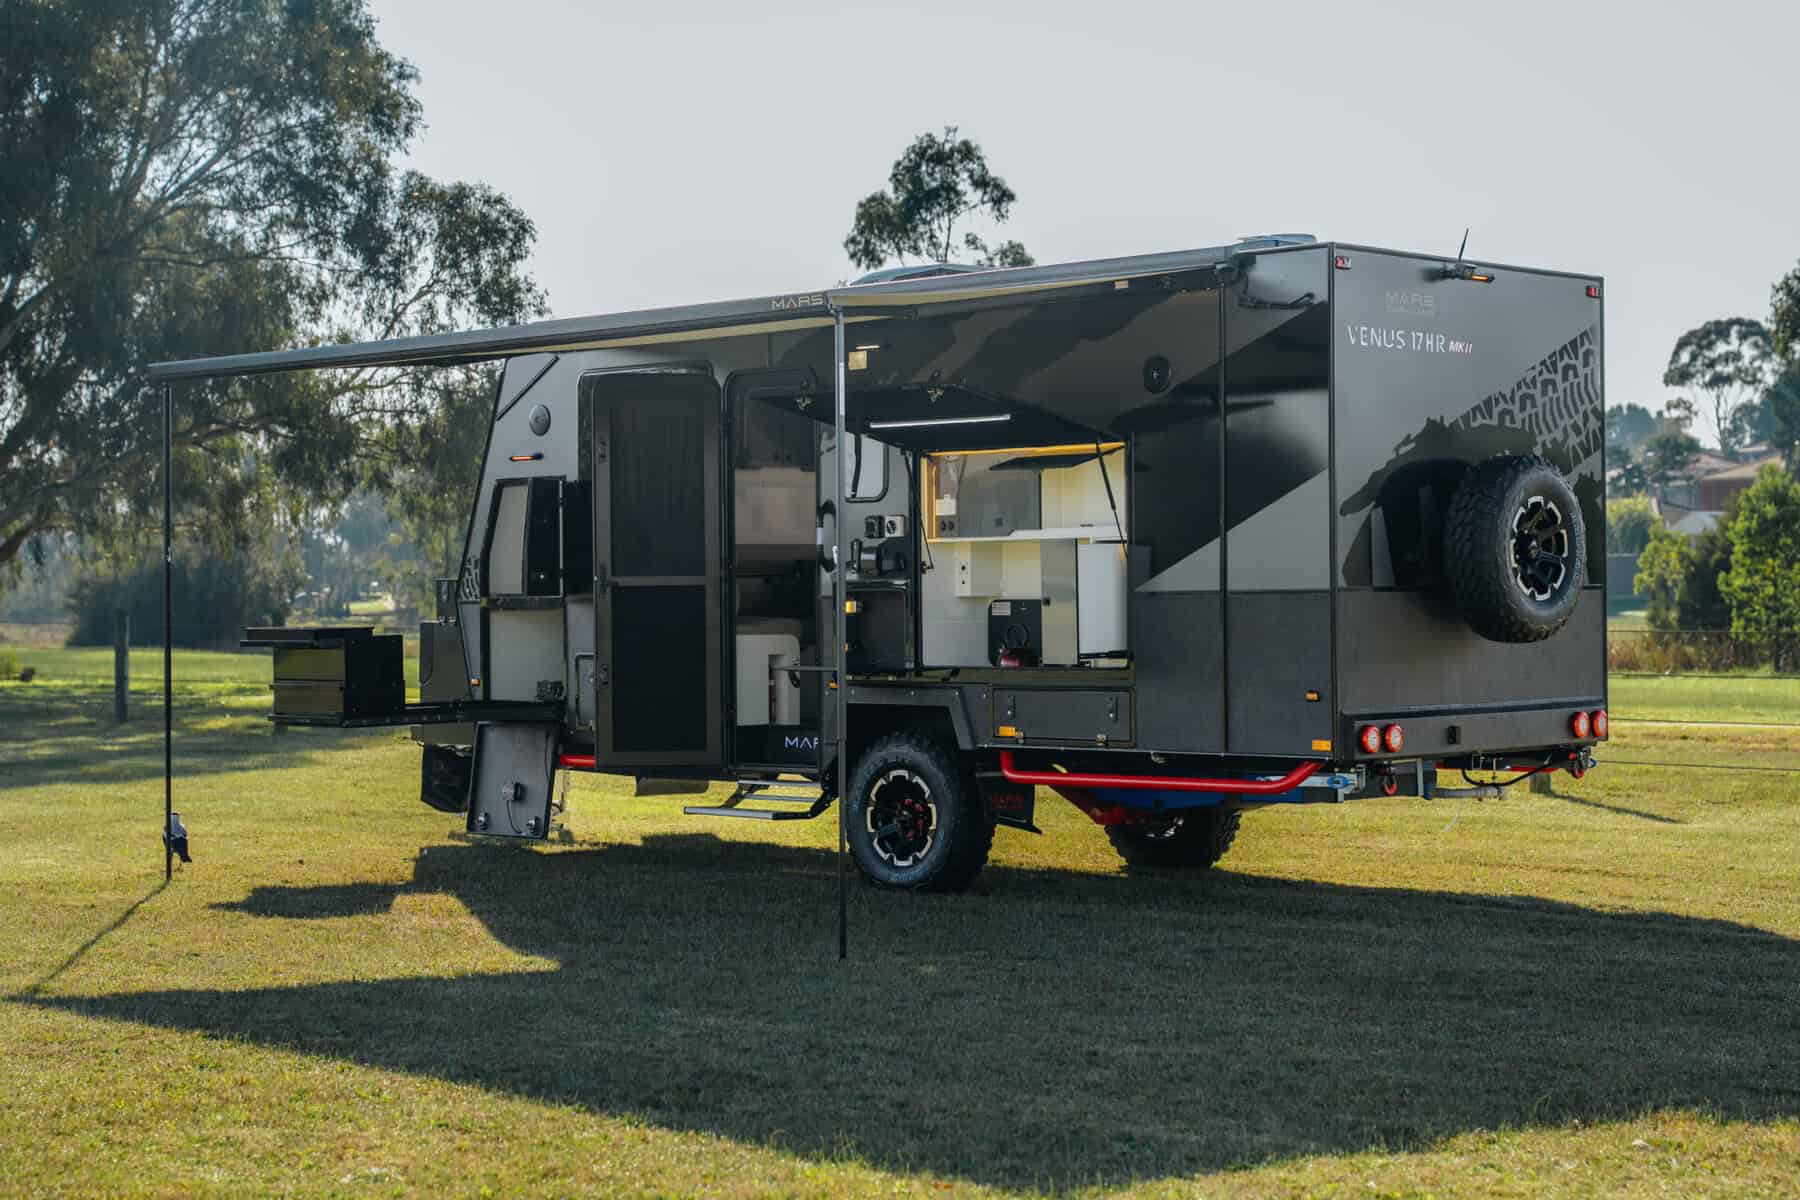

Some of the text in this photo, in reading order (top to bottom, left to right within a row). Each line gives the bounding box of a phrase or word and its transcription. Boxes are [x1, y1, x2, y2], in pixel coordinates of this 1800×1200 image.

[771, 294, 824, 310] MARS
[1347, 325, 1406, 350] VENUS
[1410, 331, 1446, 353] 17HR
[784, 735, 819, 750] MA
